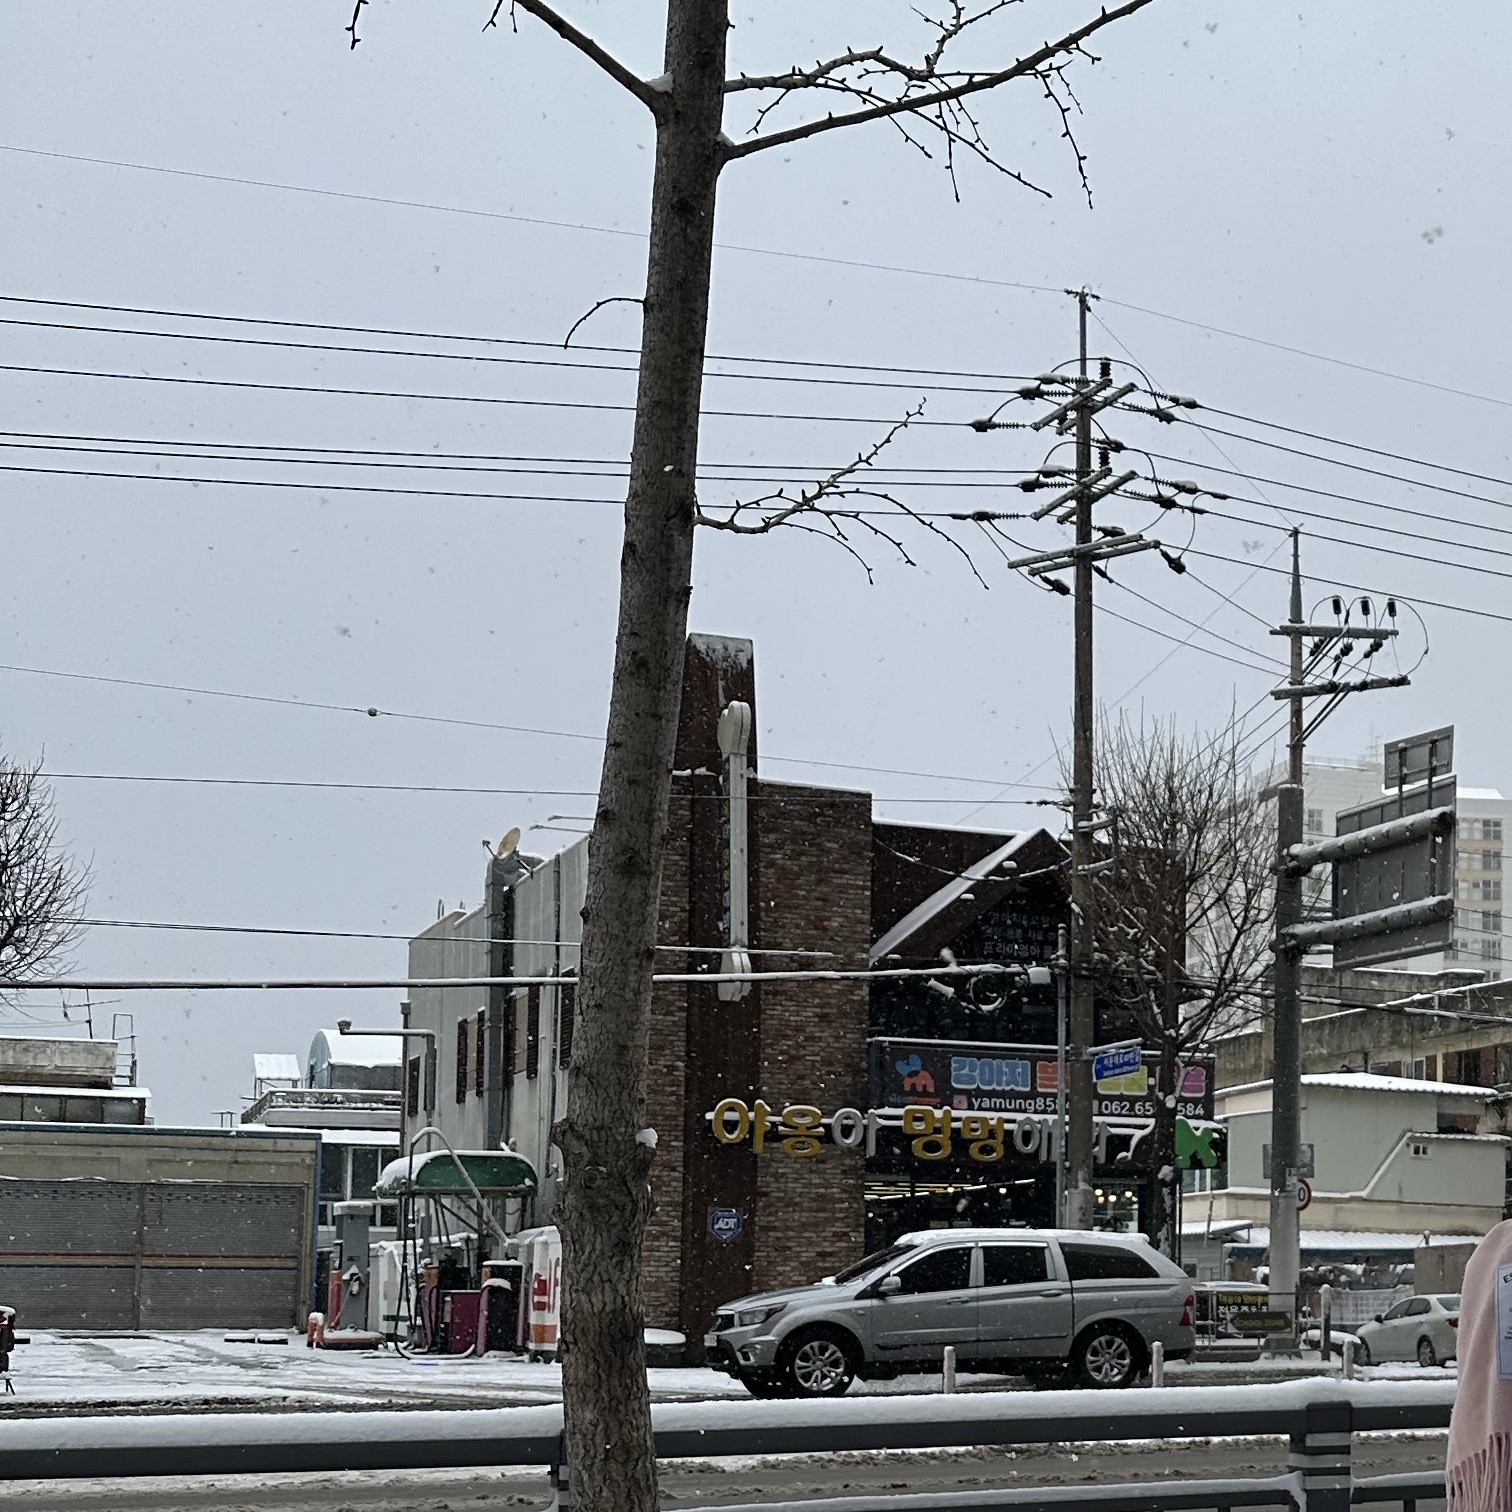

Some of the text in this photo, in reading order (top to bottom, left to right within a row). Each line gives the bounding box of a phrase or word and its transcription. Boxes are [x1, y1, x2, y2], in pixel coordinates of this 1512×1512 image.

[950, 1056, 1031, 1090] 강아지
[971, 1095, 1070, 1112] yamung85
[712, 1098, 882, 1158] 야옹아
[714, 1218, 737, 1230] ADT
